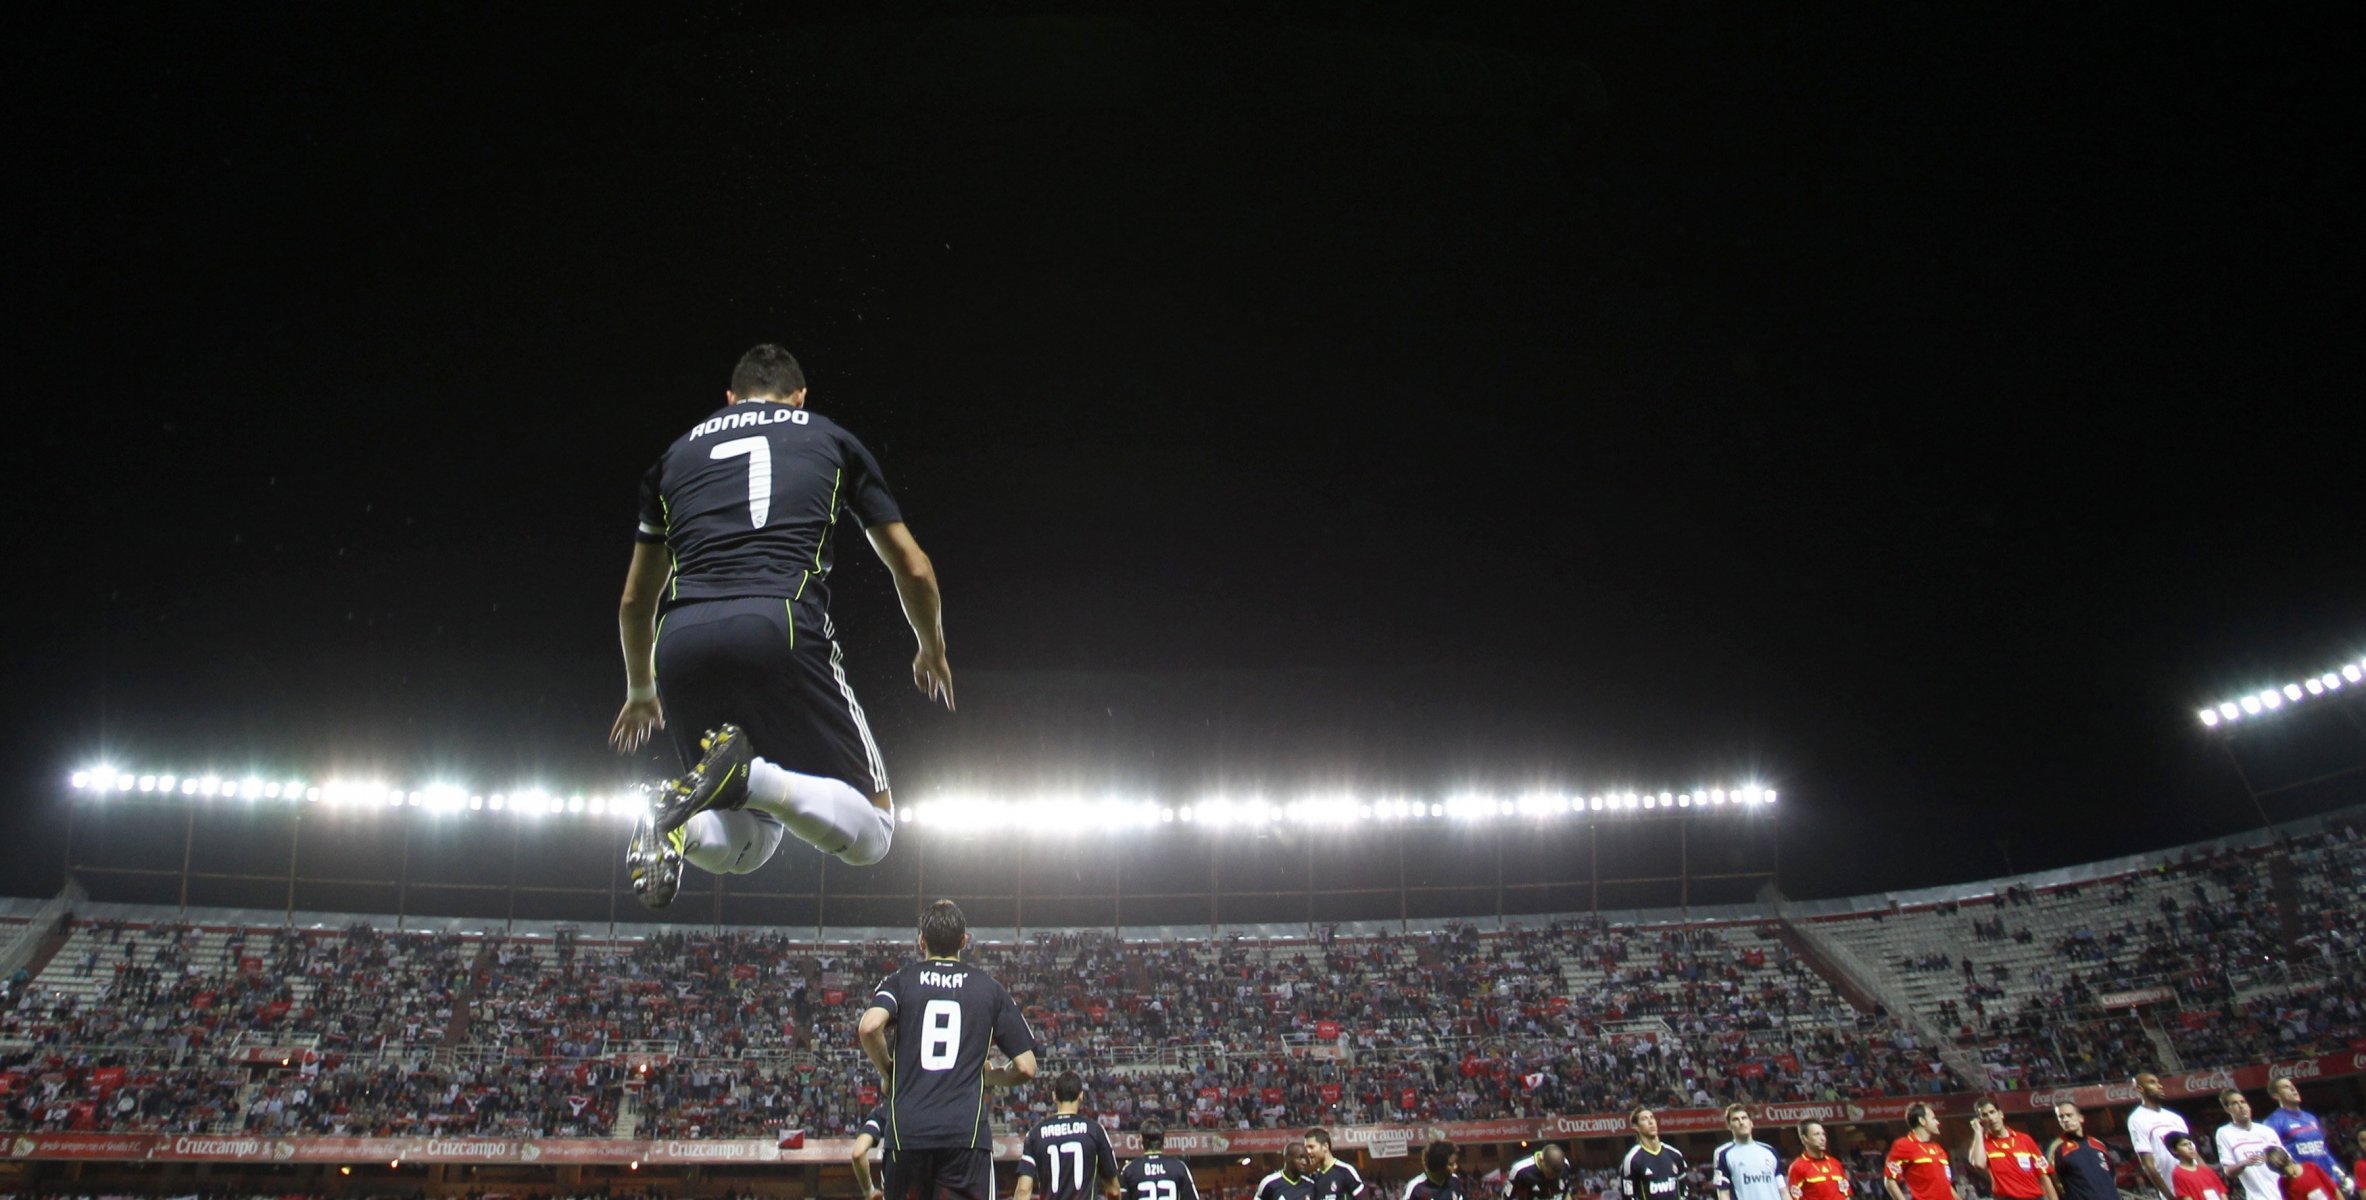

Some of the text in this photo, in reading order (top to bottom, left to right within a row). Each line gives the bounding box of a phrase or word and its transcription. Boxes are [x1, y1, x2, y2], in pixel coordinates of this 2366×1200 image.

[689, 408, 810, 441] RONALDO
[709, 435, 772, 529] 7
[920, 999, 962, 1071] 8
[1766, 1105, 1834, 1121] Cruzcampo
[1040, 1121, 1088, 1139] ARBELOA
[1558, 1118, 1626, 1133] Cruzcampo
[176, 1136, 259, 1159] Cruzcampo
[427, 1138, 506, 1159] Cruzcampo
[668, 1141, 744, 1159] Cruzcampo
[1046, 1141, 1084, 1194] 17
[1144, 1162, 1167, 1176] ÖZIL
[1743, 1171, 1773, 1185] bwin
